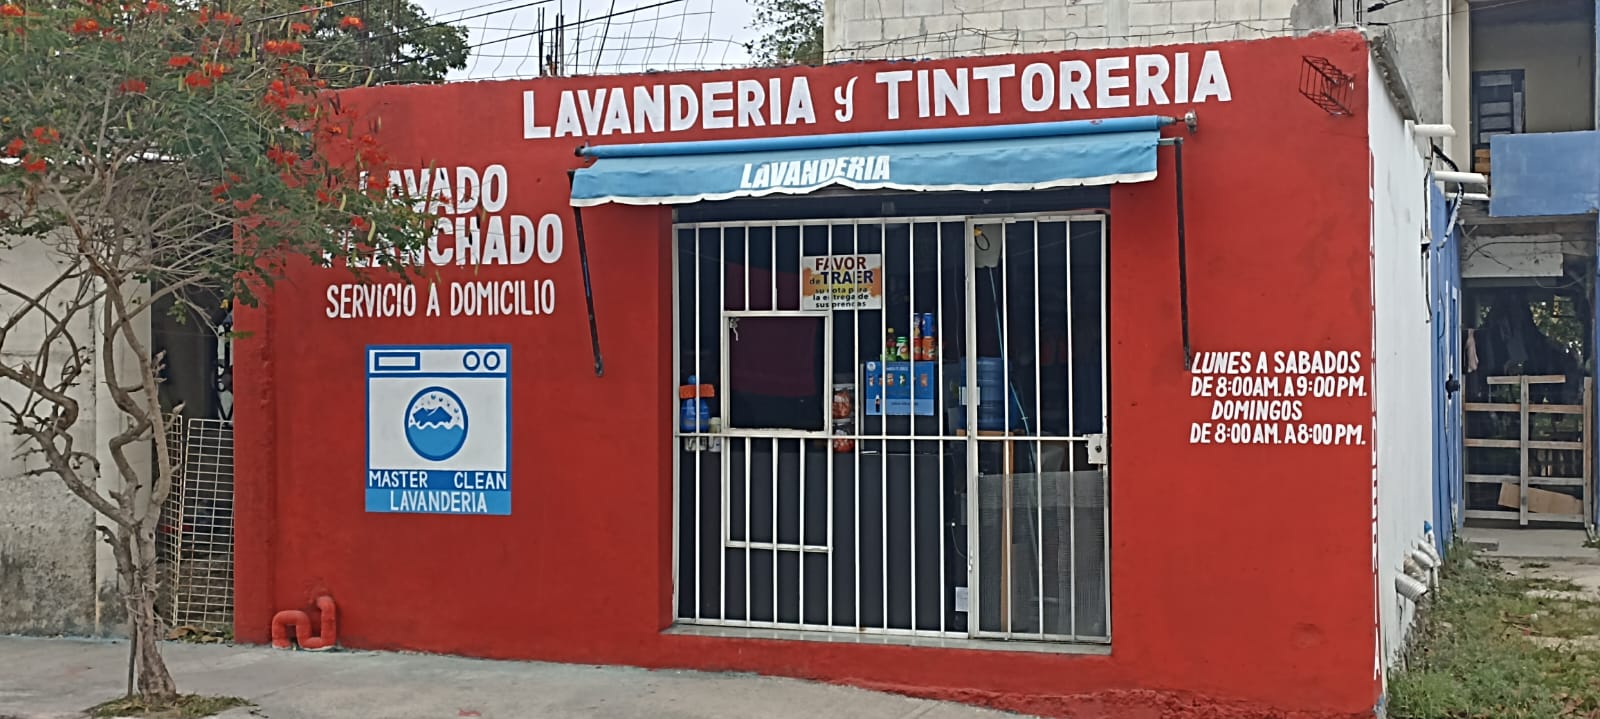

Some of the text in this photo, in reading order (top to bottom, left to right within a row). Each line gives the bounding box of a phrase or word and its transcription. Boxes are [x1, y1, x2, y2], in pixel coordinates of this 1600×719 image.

[523, 76, 816, 139] LAVANDERIA
[875, 50, 1232, 120] TINTORERIA
[739, 155, 891, 189] LAVANDERIA
[815, 256, 867, 271] FAVOR
[820, 270, 874, 284] TRAER
[326, 279, 555, 319] SERVICIO A DOMICILIO
[1191, 350, 1362, 374] LUNES A SABADOS
[1190, 376, 1213, 397] DE
[1283, 376, 1295, 397] A
[1211, 400, 1303, 421] DOMINGOS
[1189, 422, 1212, 444] DE
[1284, 423, 1297, 445] A
[369, 470, 507, 490] MASTER CLEAN
[390, 490, 488, 513] LAVANDERIA
